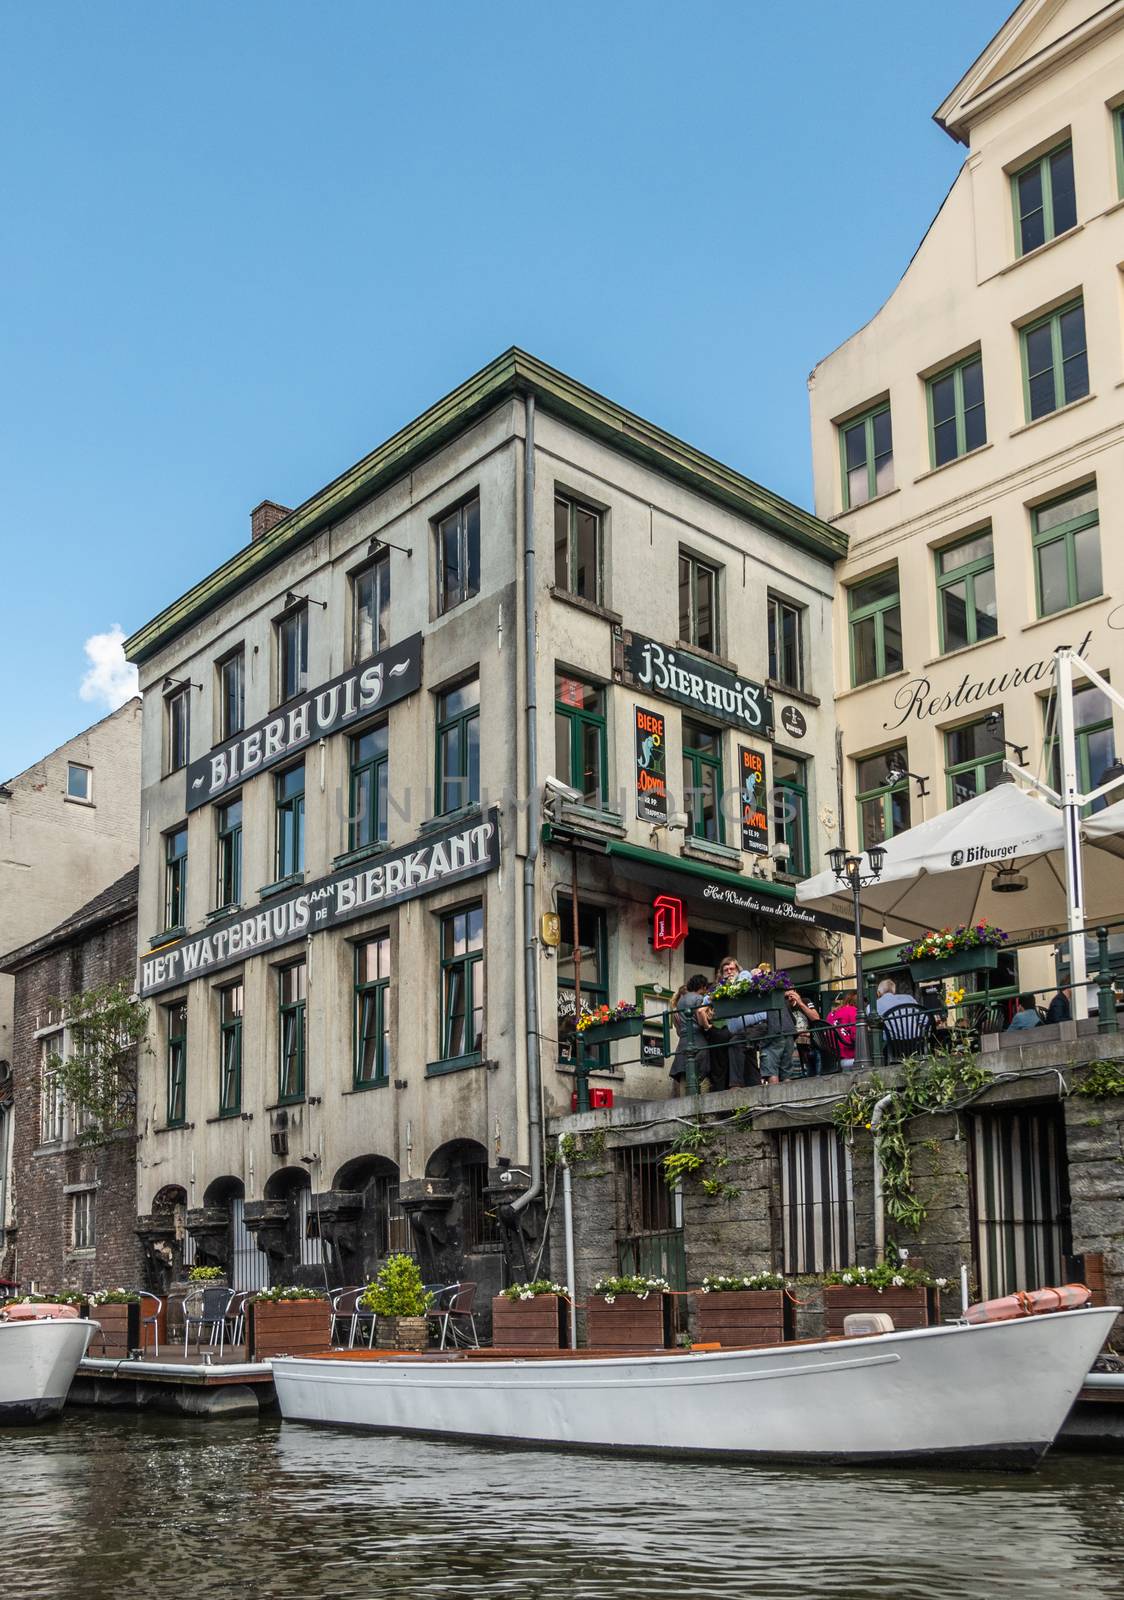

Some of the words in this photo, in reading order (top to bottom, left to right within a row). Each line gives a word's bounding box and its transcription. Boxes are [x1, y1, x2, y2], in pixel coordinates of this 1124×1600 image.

[208, 662, 385, 795] BIERHUIS
[637, 711, 663, 736] BIERE
[744, 751, 762, 772] BIER
[966, 845, 1018, 862] Bitburger
[334, 822, 494, 917] BIERKANT
[310, 884, 335, 904] AAN
[315, 907, 328, 921] DE
[760, 905, 774, 914] aan
[774, 904, 783, 915] de
[180, 894, 311, 976] WATERHUIS
[142, 949, 180, 990] HET
